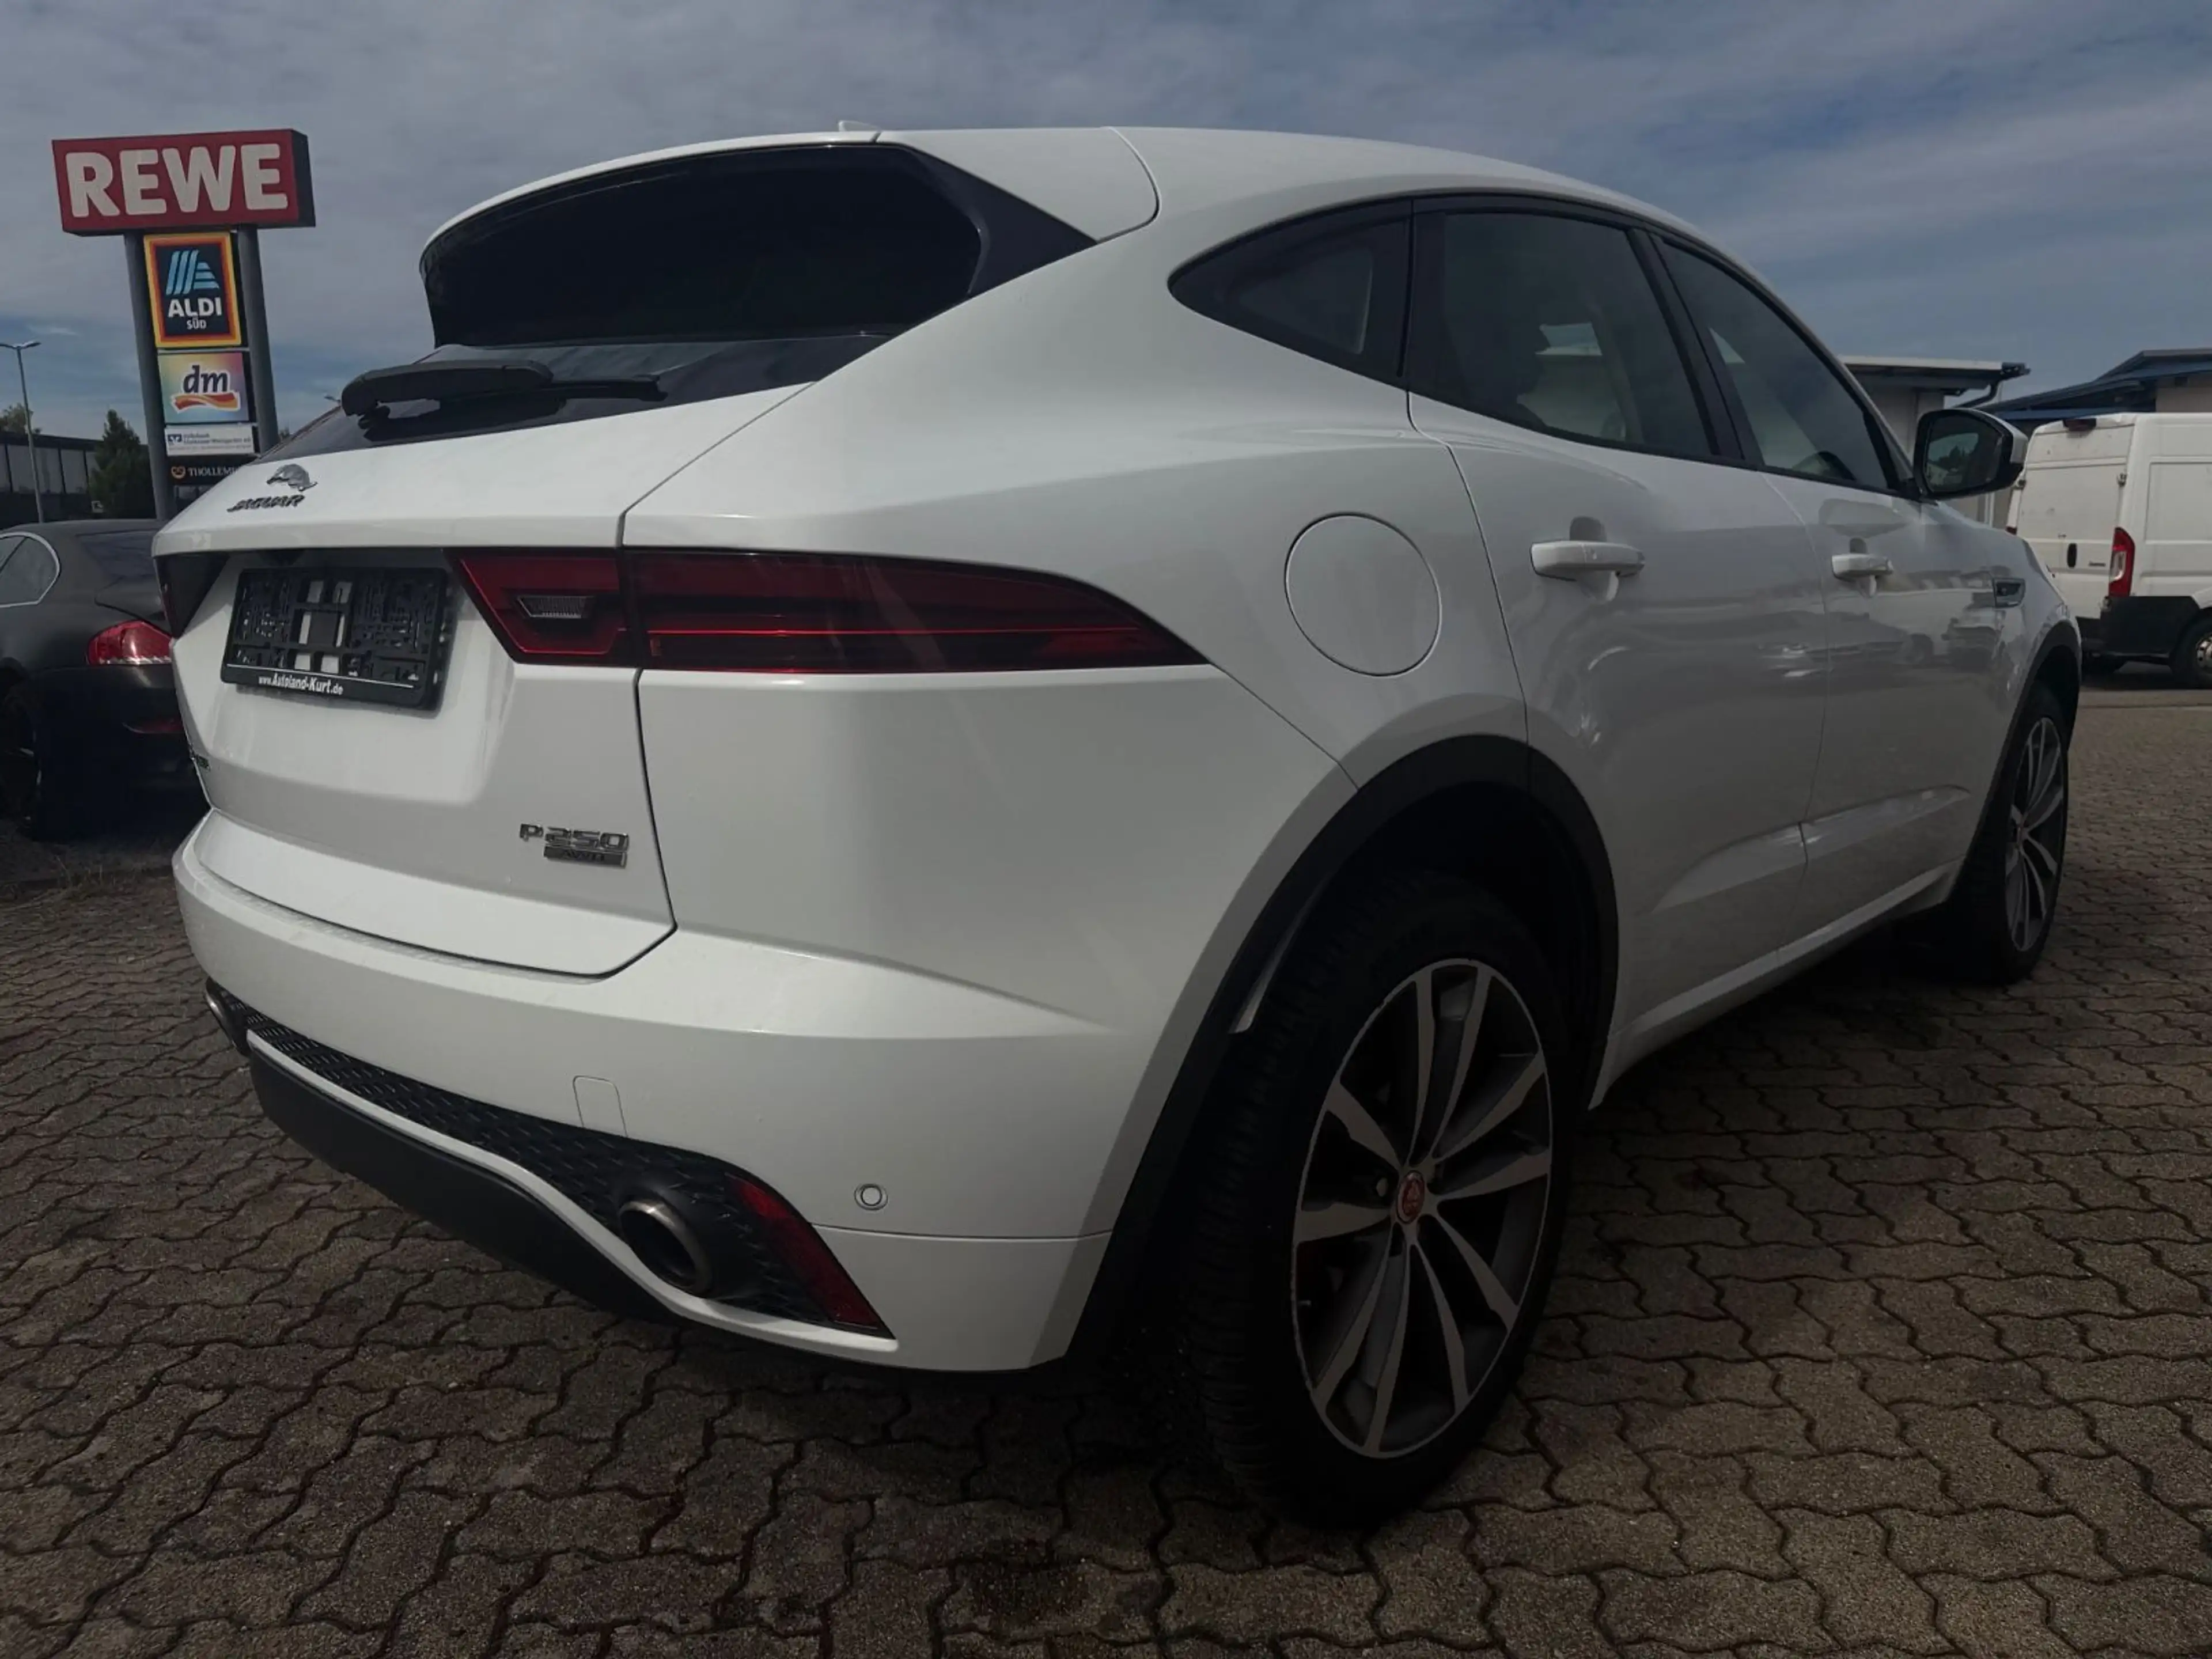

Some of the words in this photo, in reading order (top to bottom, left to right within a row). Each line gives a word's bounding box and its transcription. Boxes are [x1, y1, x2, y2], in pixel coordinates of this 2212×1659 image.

[65, 143, 289, 218] REWE
[167, 297, 222, 318] ALDI
[186, 316, 207, 330] SÜD
[183, 365, 229, 395] dm
[226, 494, 306, 513] JAGUAR
[257, 672, 344, 695] www.Autoland-Kurt.de
[519, 823, 629, 851] P250
